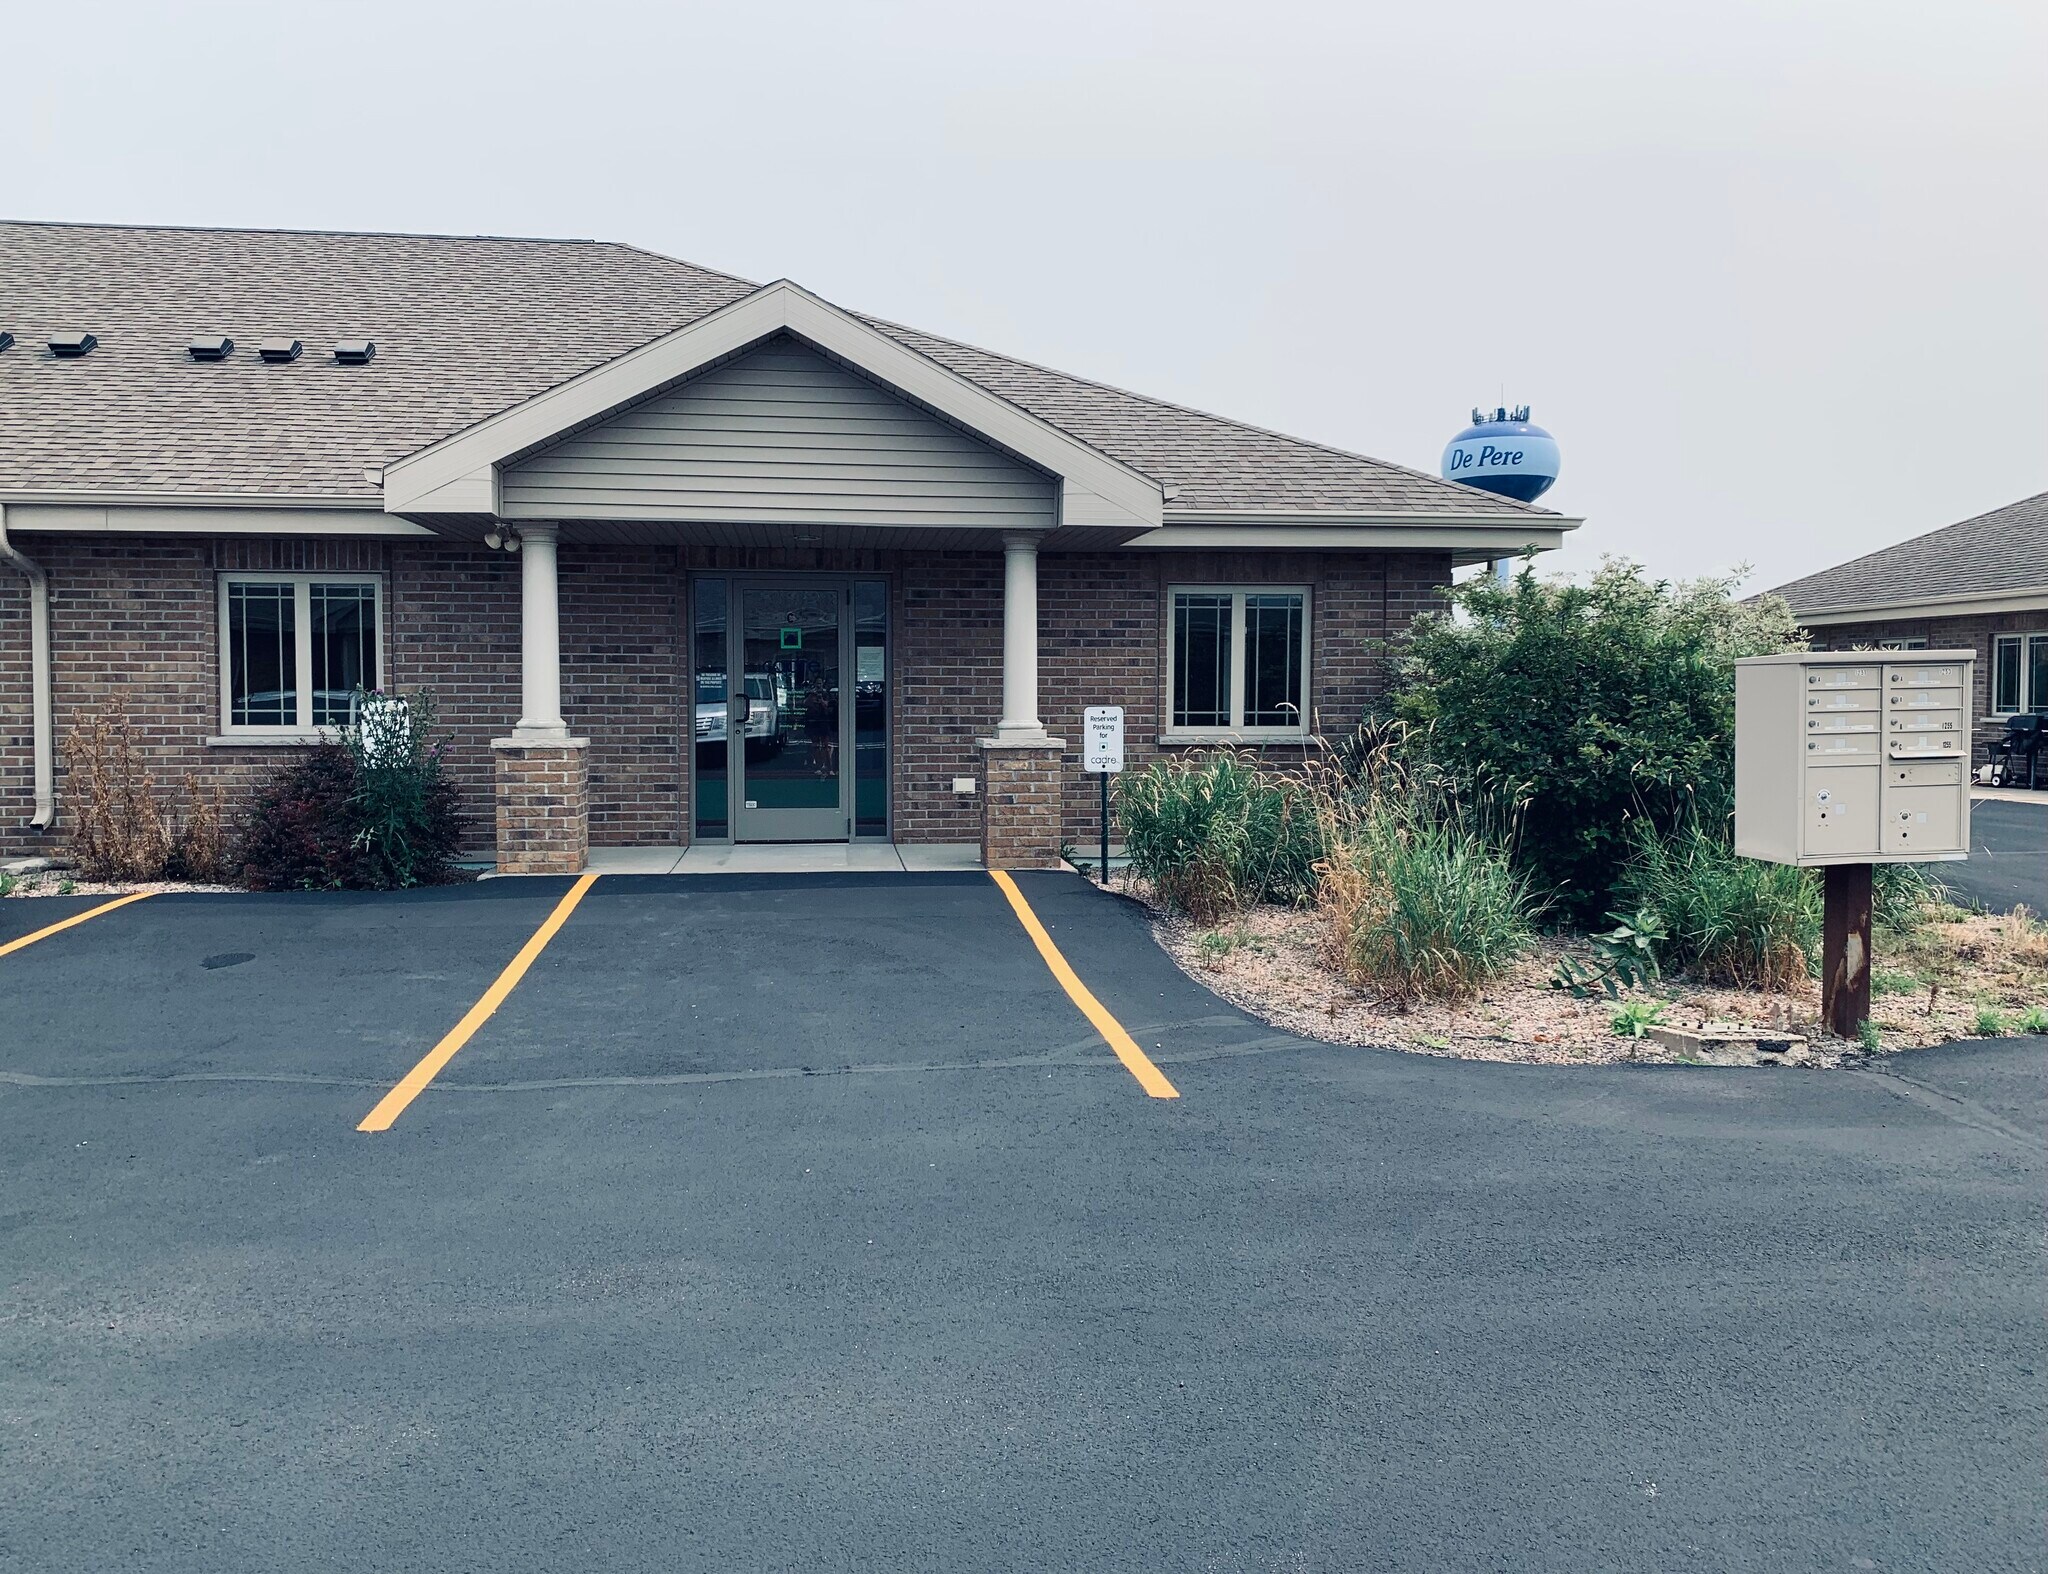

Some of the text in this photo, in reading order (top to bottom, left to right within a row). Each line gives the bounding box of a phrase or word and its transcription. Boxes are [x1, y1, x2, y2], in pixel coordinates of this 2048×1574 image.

[1450, 445, 1524, 470] De Pere
[1090, 755, 1117, 764] cadre
